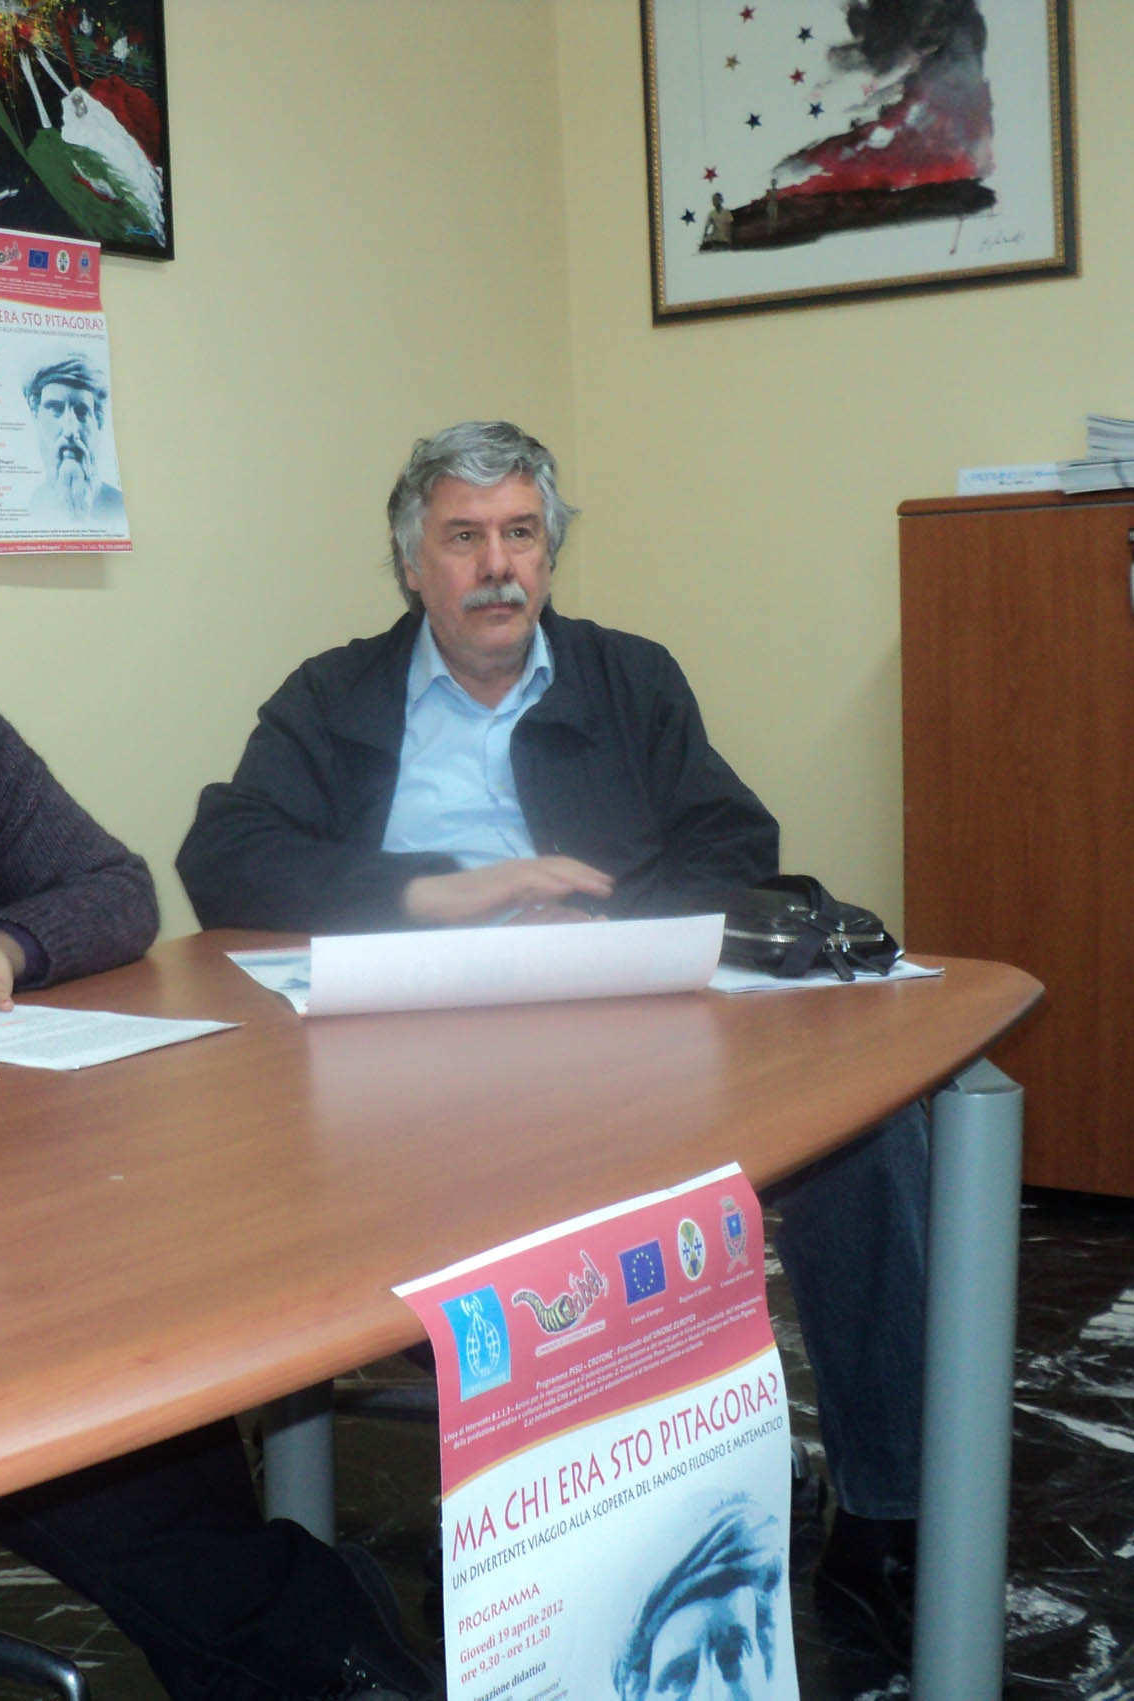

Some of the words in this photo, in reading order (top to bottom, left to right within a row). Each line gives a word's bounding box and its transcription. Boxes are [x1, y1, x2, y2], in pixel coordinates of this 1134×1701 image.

[0, 309, 18, 324] ERA
[21, 311, 42, 326] STO
[45, 313, 104, 331] PITAGORA?
[452, 1504, 497, 1562] MA
[504, 1476, 549, 1530] CHI
[558, 1452, 605, 1505] ERA
[610, 1428, 652, 1480] STO
[659, 1371, 778, 1456] PITAGORA?
[452, 1569, 467, 1590] UN
[469, 1540, 526, 1581] DIVERTENTE
[527, 1520, 567, 1550] VIAGGIO
[569, 1509, 592, 1531] ALLA
[592, 1488, 635, 1520] SCOPERTA
[635, 1479, 652, 1497] DEL
[652, 1461, 688, 1489] FAMOSO
[688, 1443, 726, 1472] FILOSOFO
[726, 1440, 732, 1454] E
[732, 1415, 784, 1450] MATEMATICO
[458, 1583, 541, 1636] PROGRAMMA
[498, 1627, 510, 1644] 19
[511, 1614, 539, 1638] aprile
[540, 1599, 564, 1622] 2012
[460, 1667, 477, 1685] ore
[507, 1642, 523, 1659] ore
[511, 1661, 547, 1688] didattica
